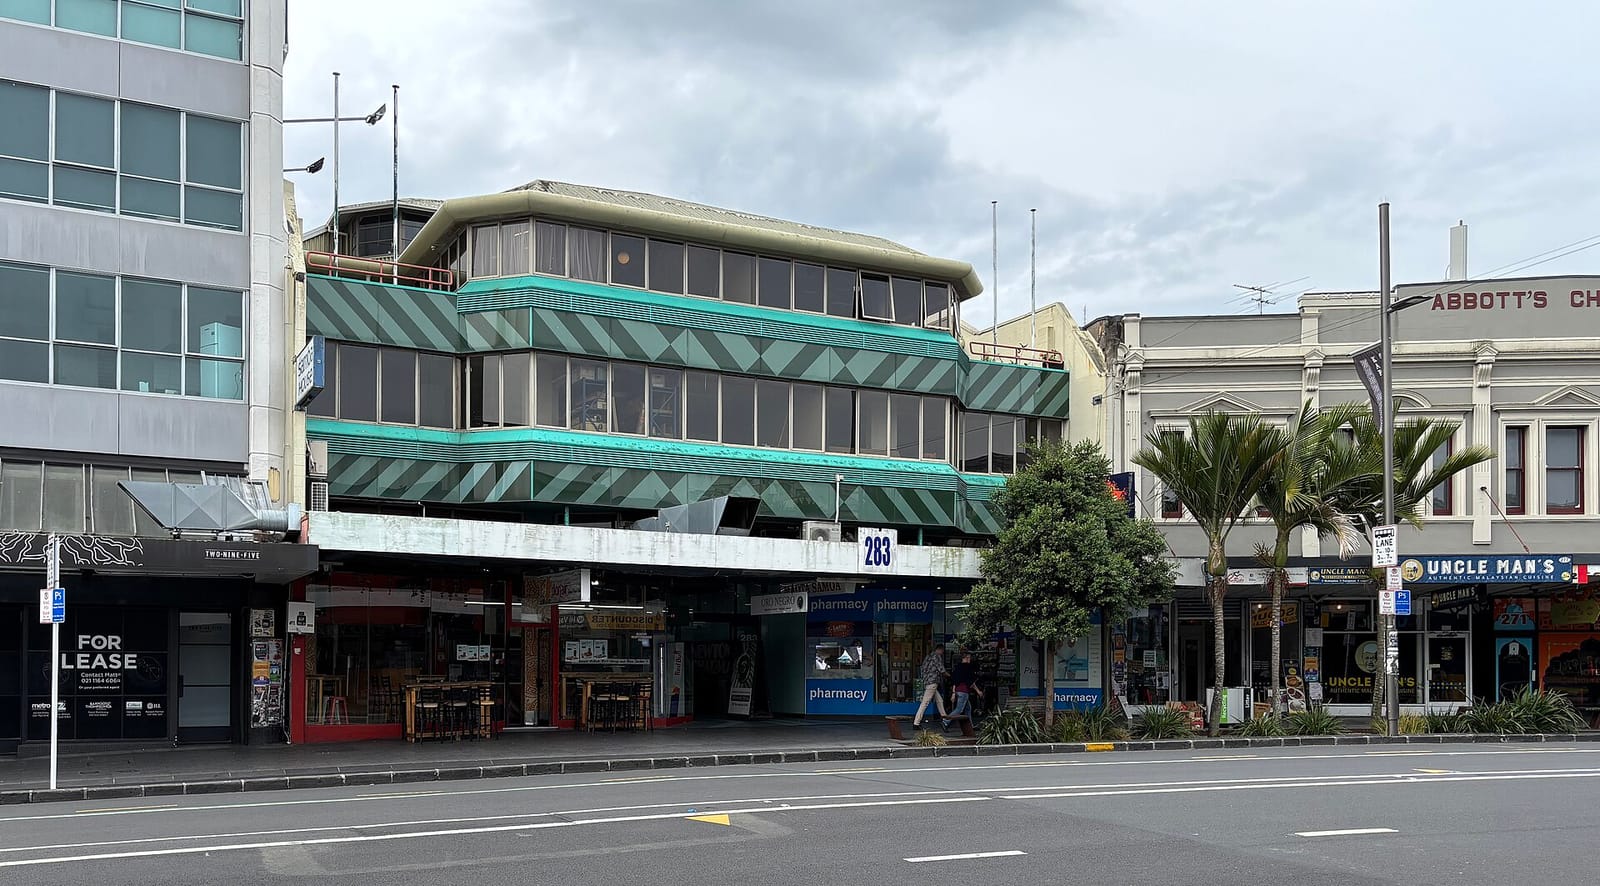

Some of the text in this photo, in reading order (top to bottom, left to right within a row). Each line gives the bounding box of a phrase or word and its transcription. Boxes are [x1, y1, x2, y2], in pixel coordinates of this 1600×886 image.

[1431, 291, 1548, 310] ABBOTT'S
[1375, 539, 1393, 547] LANE
[865, 536, 890, 566] 283
[1428, 560, 1486, 575] UNCLE
[1497, 560, 1553, 574] MAN'S
[1439, 590, 1456, 602] UNCLE
[811, 599, 868, 612] pharmacy
[877, 598, 928, 612] pharmacy
[1501, 614, 1527, 625] 271
[78, 635, 121, 650] FOR
[61, 653, 137, 669] LEASE
[1329, 677, 1371, 686] UNCLE
[810, 687, 867, 701] pharmacy
[1054, 693, 1097, 704] harmacy
